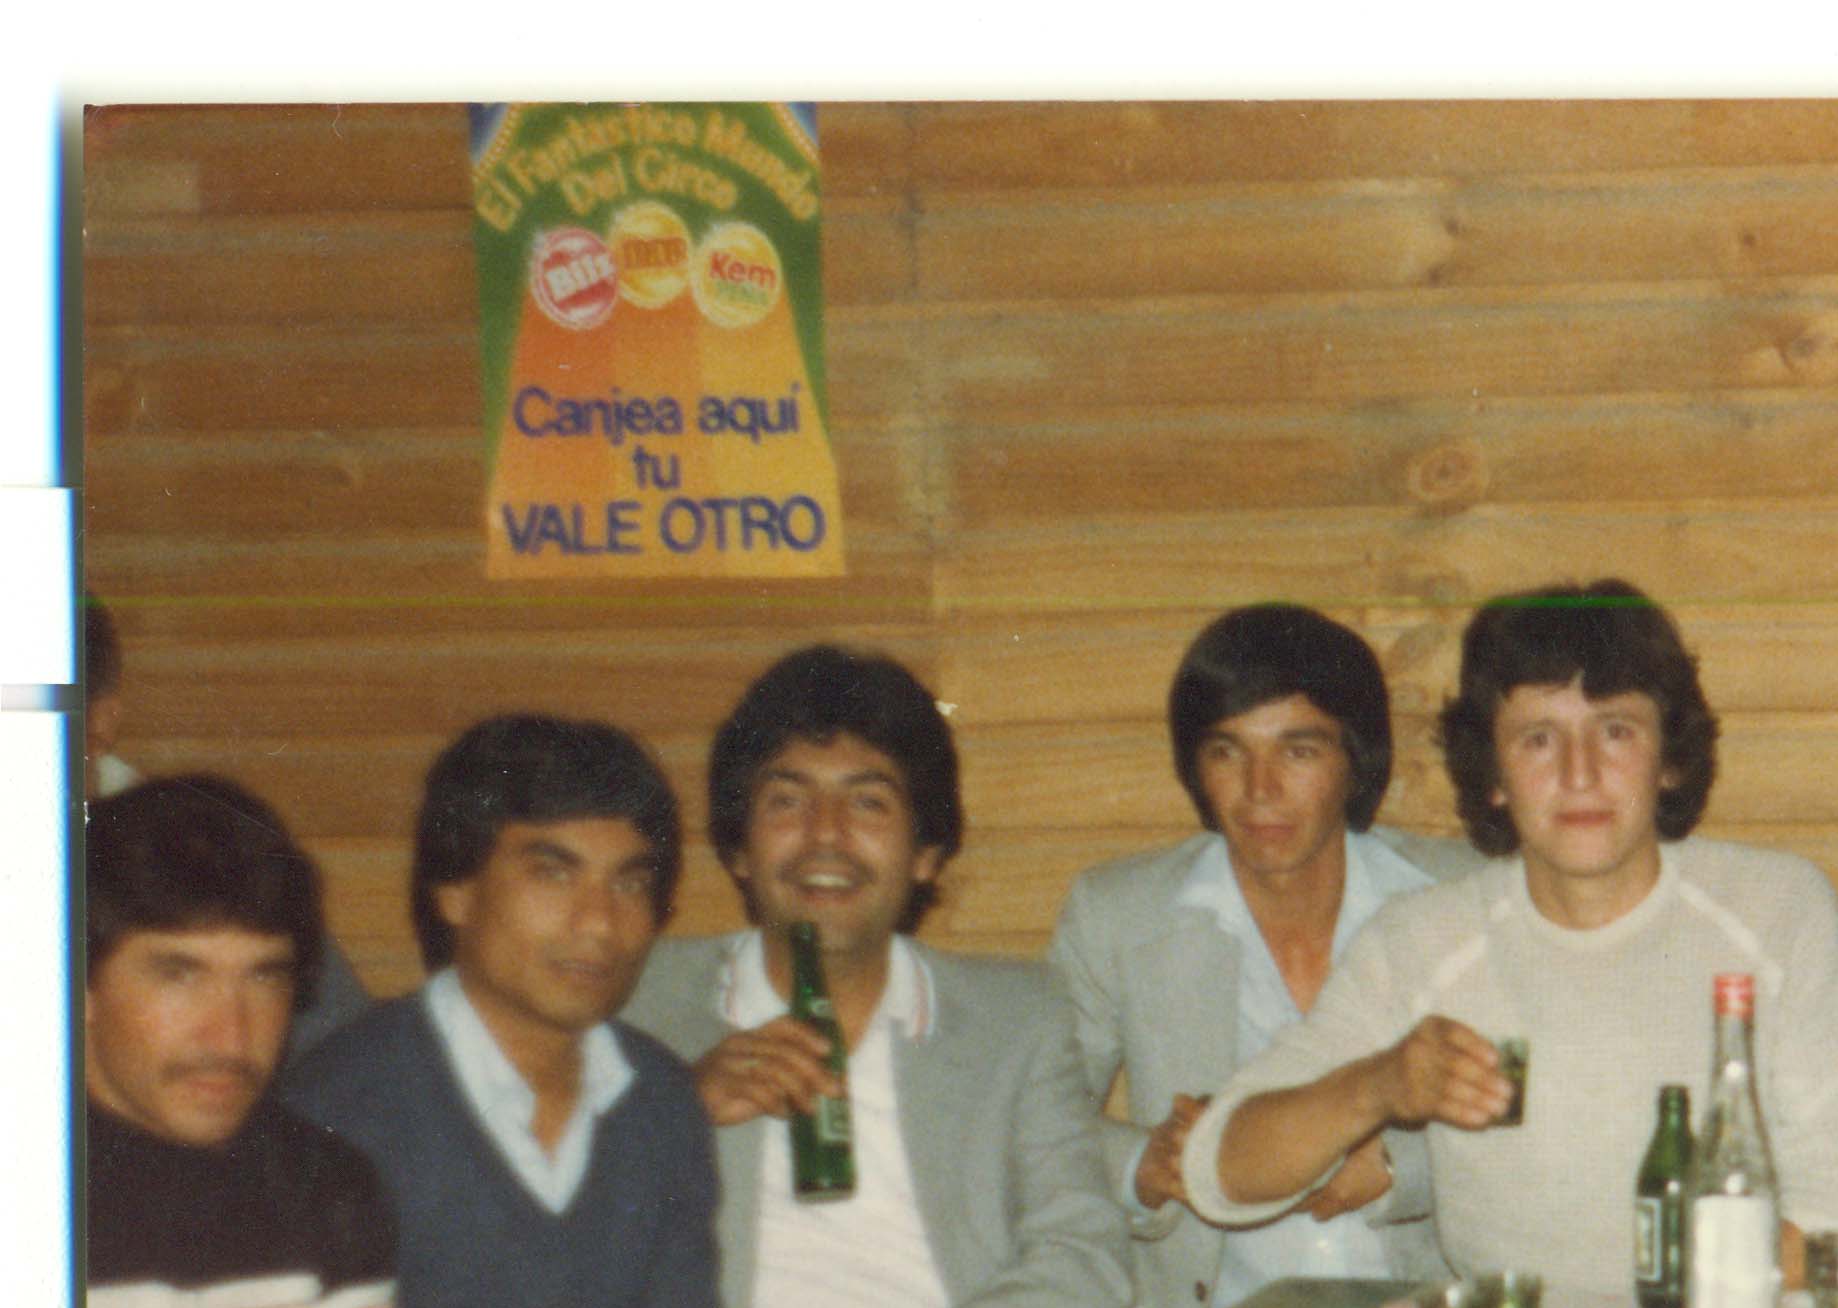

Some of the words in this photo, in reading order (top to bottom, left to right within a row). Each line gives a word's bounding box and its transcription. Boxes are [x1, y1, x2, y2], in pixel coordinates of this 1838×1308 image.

[475, 171, 523, 233] El
[703, 108, 819, 218] Mundo
[561, 154, 628, 215] Del
[634, 150, 738, 212] Circo
[709, 249, 777, 291] Kem
[513, 385, 685, 446] Canjea
[632, 445, 680, 489] tu
[503, 502, 642, 555] VALE
[660, 495, 826, 554] OTRO
